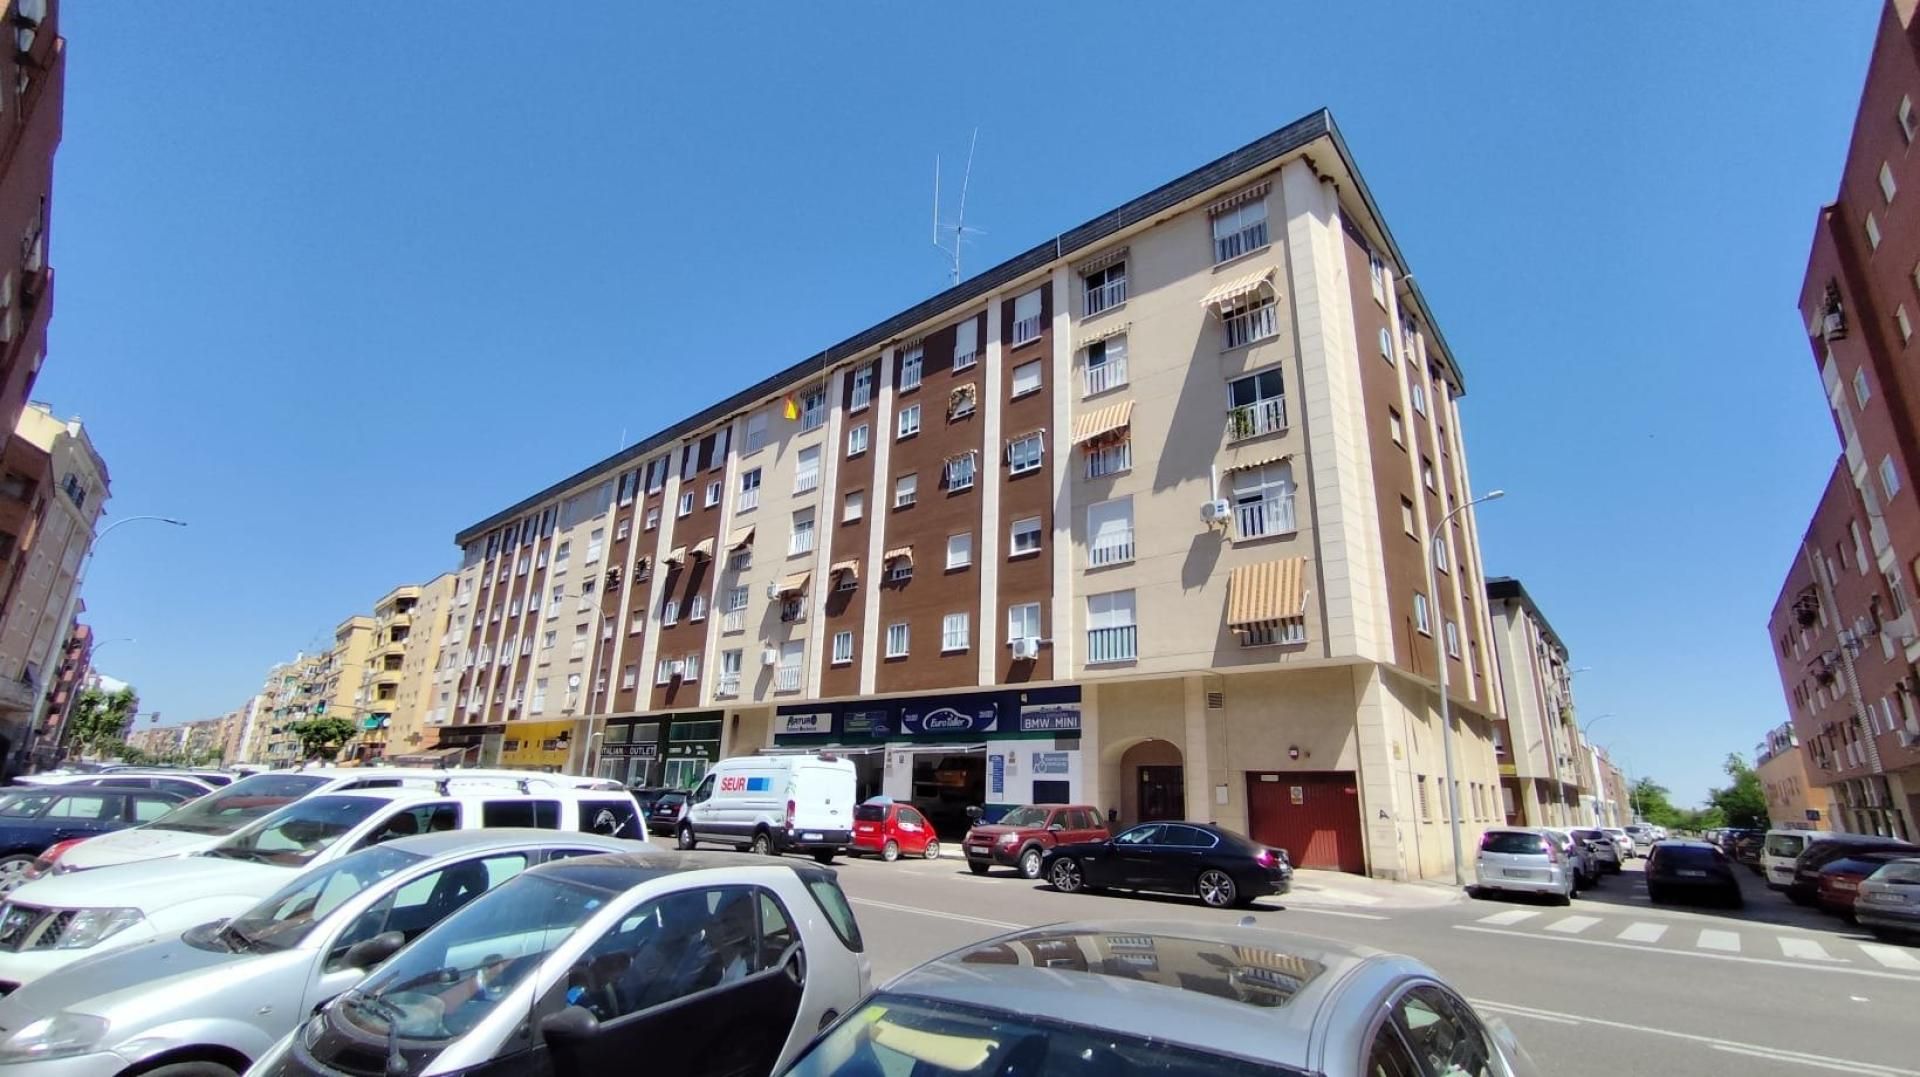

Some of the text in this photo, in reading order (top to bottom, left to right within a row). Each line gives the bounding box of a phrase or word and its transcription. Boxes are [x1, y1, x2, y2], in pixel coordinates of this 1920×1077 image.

[1025, 717, 1078, 729] BMW MINI
[629, 746, 654, 755] OUTLET
[721, 777, 746, 791] SEUR
